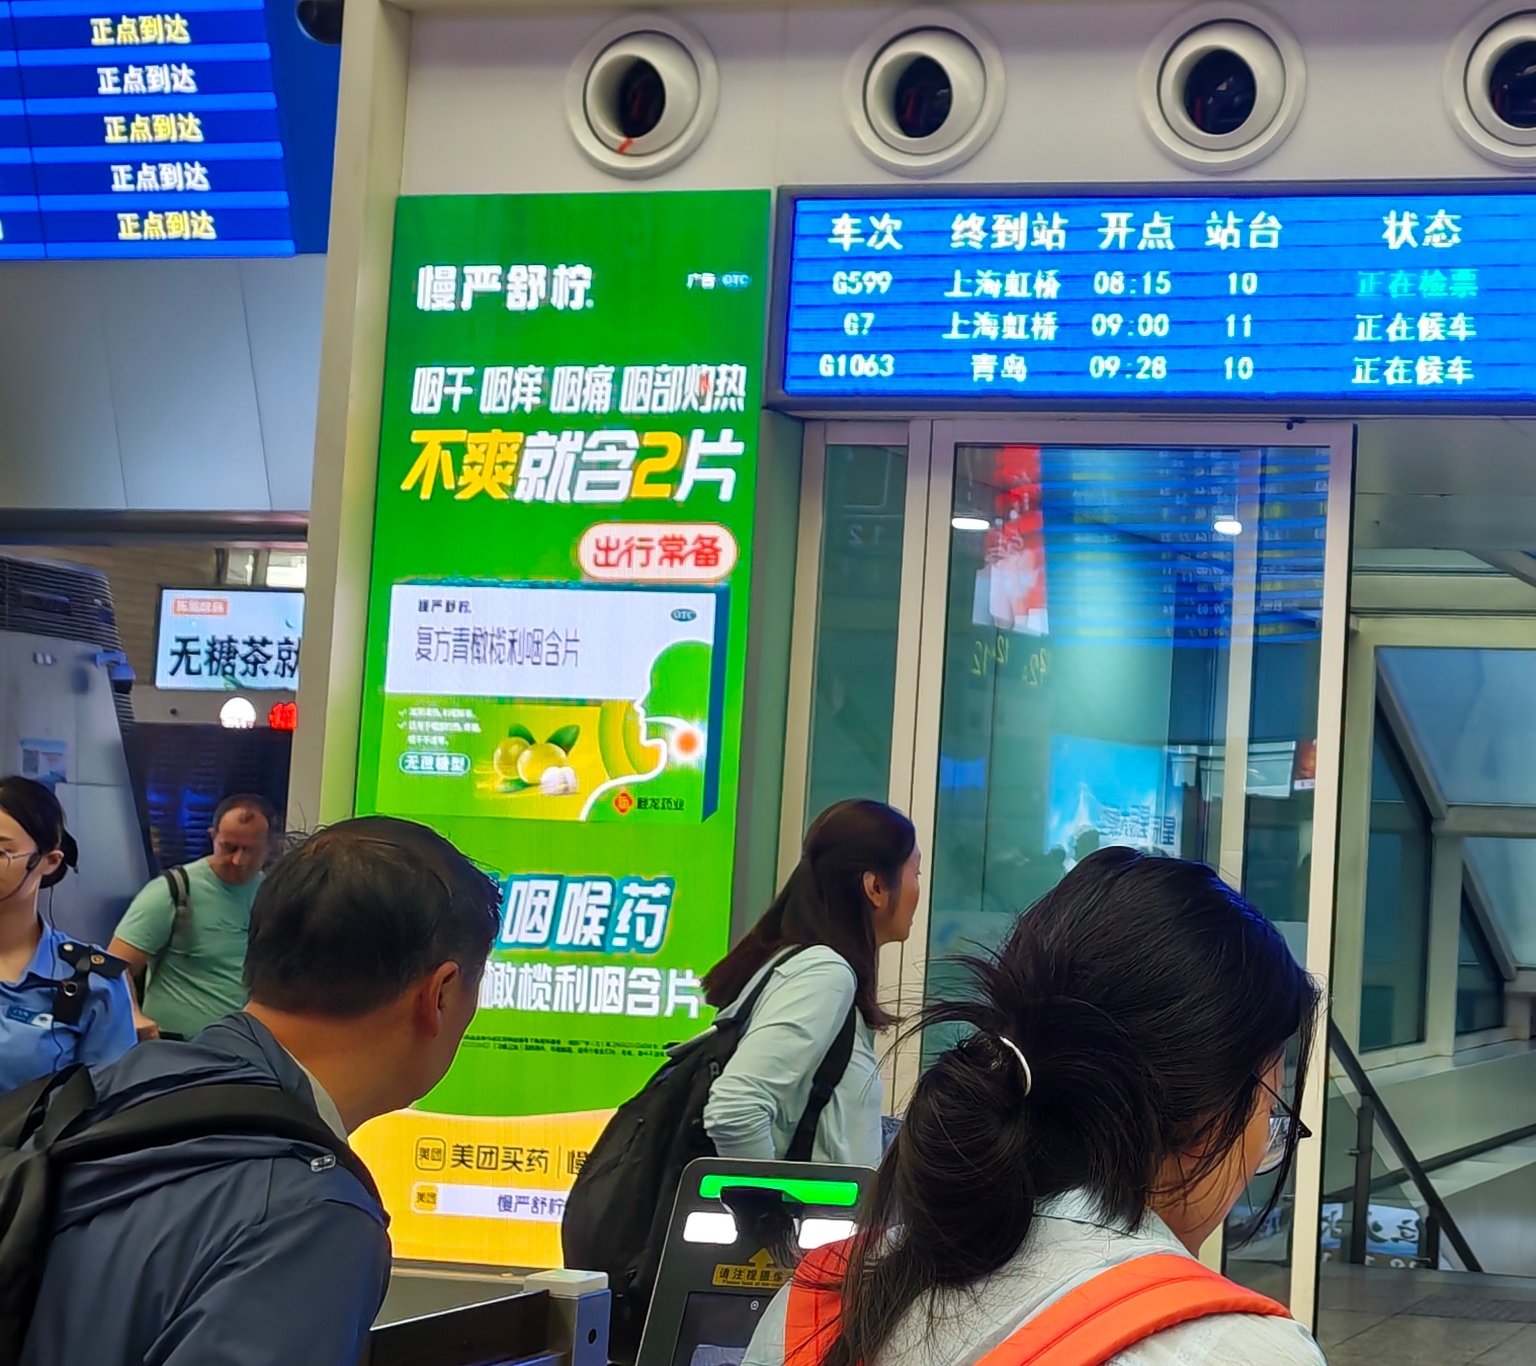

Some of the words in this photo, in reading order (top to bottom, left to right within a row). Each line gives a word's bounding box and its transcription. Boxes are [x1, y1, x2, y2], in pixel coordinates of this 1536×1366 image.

[90, 14, 191, 46] 正点到达
[97, 63, 198, 95] 正点到达
[104, 112, 204, 144] 正点到达
[111, 161, 211, 193] 正点到达
[117, 210, 218, 241] 正点到达
[828, 213, 903, 251] 车次
[949, 211, 1069, 251] 终到站
[1098, 211, 1175, 251] 开点
[1204, 210, 1283, 250] 站台
[1382, 208, 1462, 250] 状态
[416, 264, 591, 311] 慢严舒柠
[832, 270, 893, 295] G599
[944, 269, 1060, 299] 上海虹桥
[1093, 271, 1171, 295] 08:15
[1228, 272, 1258, 295] 10
[1357, 269, 1479, 299] 正在检票
[844, 312, 875, 336] G7
[942, 311, 1059, 341] 上海虹桥
[1092, 313, 1169, 337] 09:00
[1226, 314, 1252, 337] 11
[1354, 313, 1477, 342] 正在候车
[819, 354, 895, 377] G1063
[970, 353, 1028, 382] 青岛
[1090, 355, 1167, 379] 09:28
[1224, 357, 1253, 380] 10
[1351, 356, 1474, 385] 正在候车
[410, 365, 475, 414] 咽干
[479, 364, 544, 413] 咽痒
[549, 364, 614, 414] 咽痛
[619, 364, 746, 413] 咽部灼热
[400, 428, 744, 503] 不爽就含2片
[592, 535, 722, 569] 出行常备
[415, 625, 580, 666] 复方青橄榄利咽含片
[499, 880, 671, 948] 咽喉药
[451, 1144, 549, 1174] 美团买药
[719, 1267, 784, 1282] 请注视摄像
